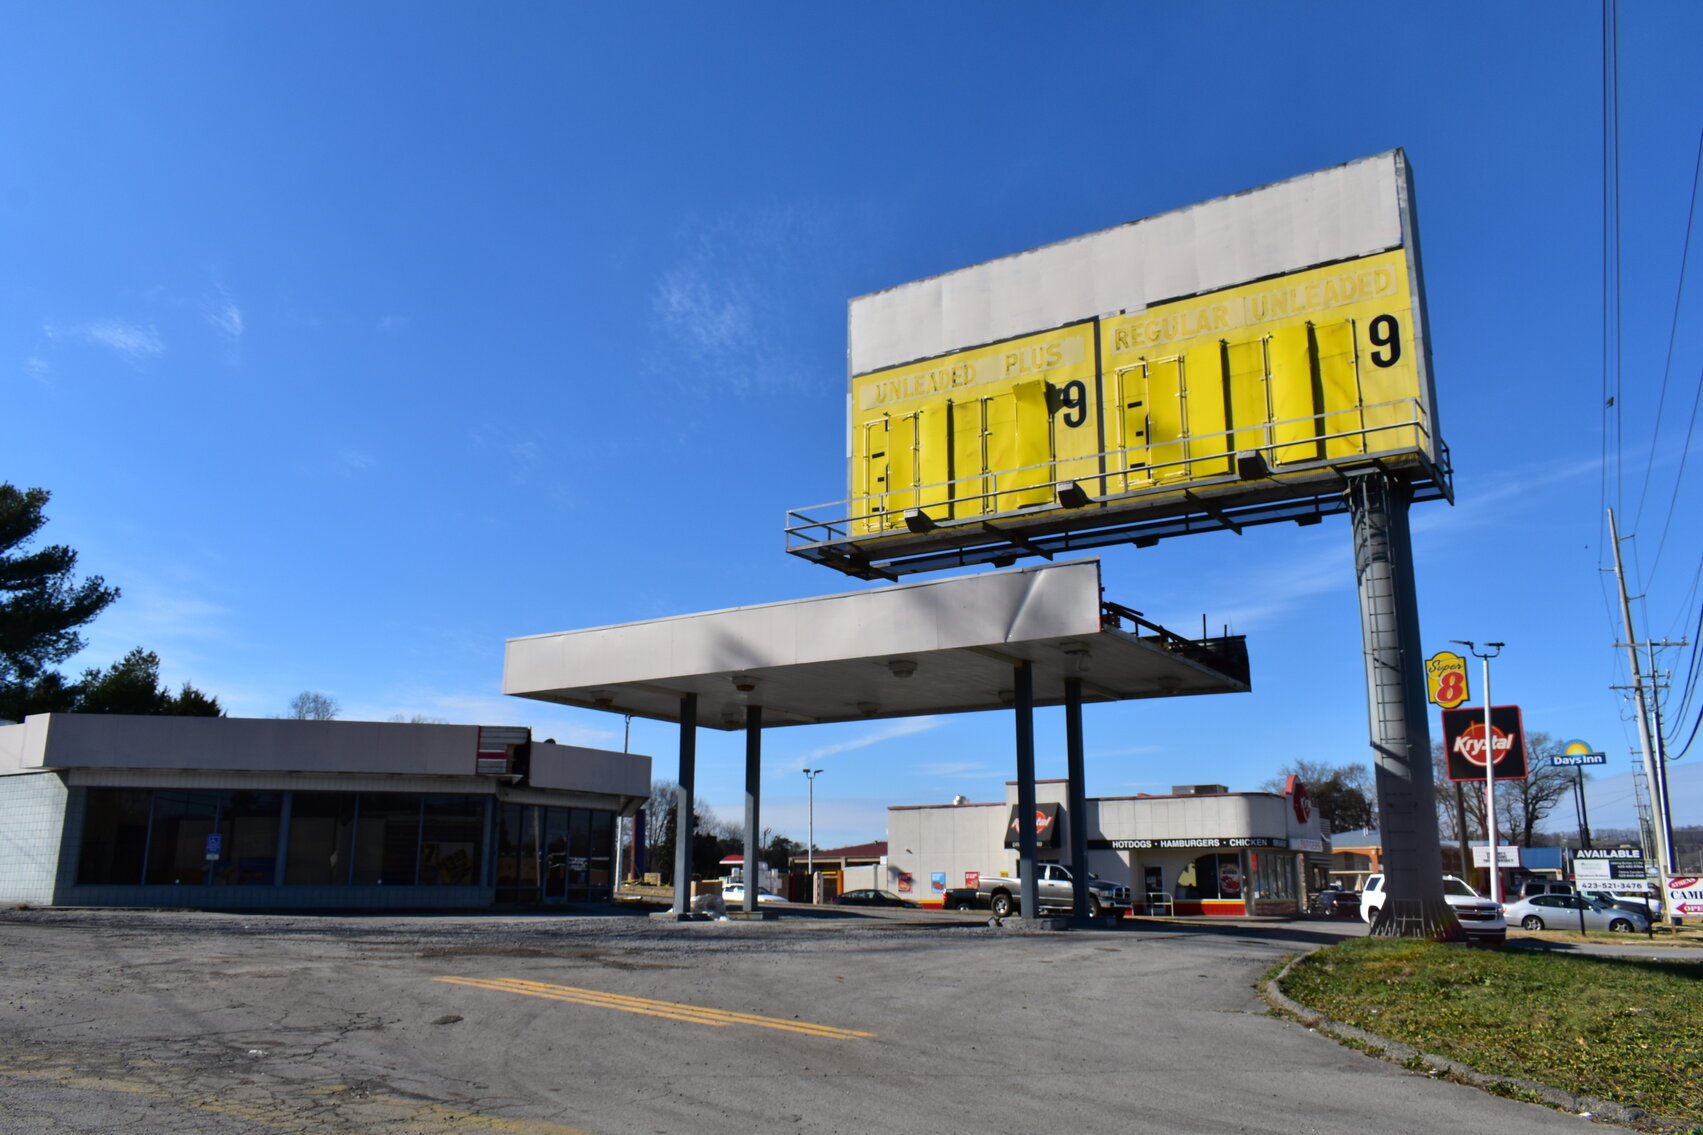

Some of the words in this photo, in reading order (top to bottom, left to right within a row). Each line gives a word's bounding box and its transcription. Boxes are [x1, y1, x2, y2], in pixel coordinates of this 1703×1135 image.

[1114, 305, 1230, 352] REGULAR
[1251, 268, 1393, 321] UNLEADED
[1369, 314, 1401, 368] 9
[876, 363, 977, 404] UNLEADED
[1005, 343, 1062, 376] PLUS
[1062, 380, 1087, 428] 9
[1428, 659, 1462, 678] Super
[1434, 671, 1464, 703] 8
[1554, 756, 1582, 766] Days
[1582, 755, 1603, 764] Inn
[1112, 840, 1152, 849] HOTDOGS
[1160, 839, 1220, 848] HAMBURGERS
[1229, 838, 1268, 847] CHICKEN
[1576, 850, 1640, 858] AVAILABLE
